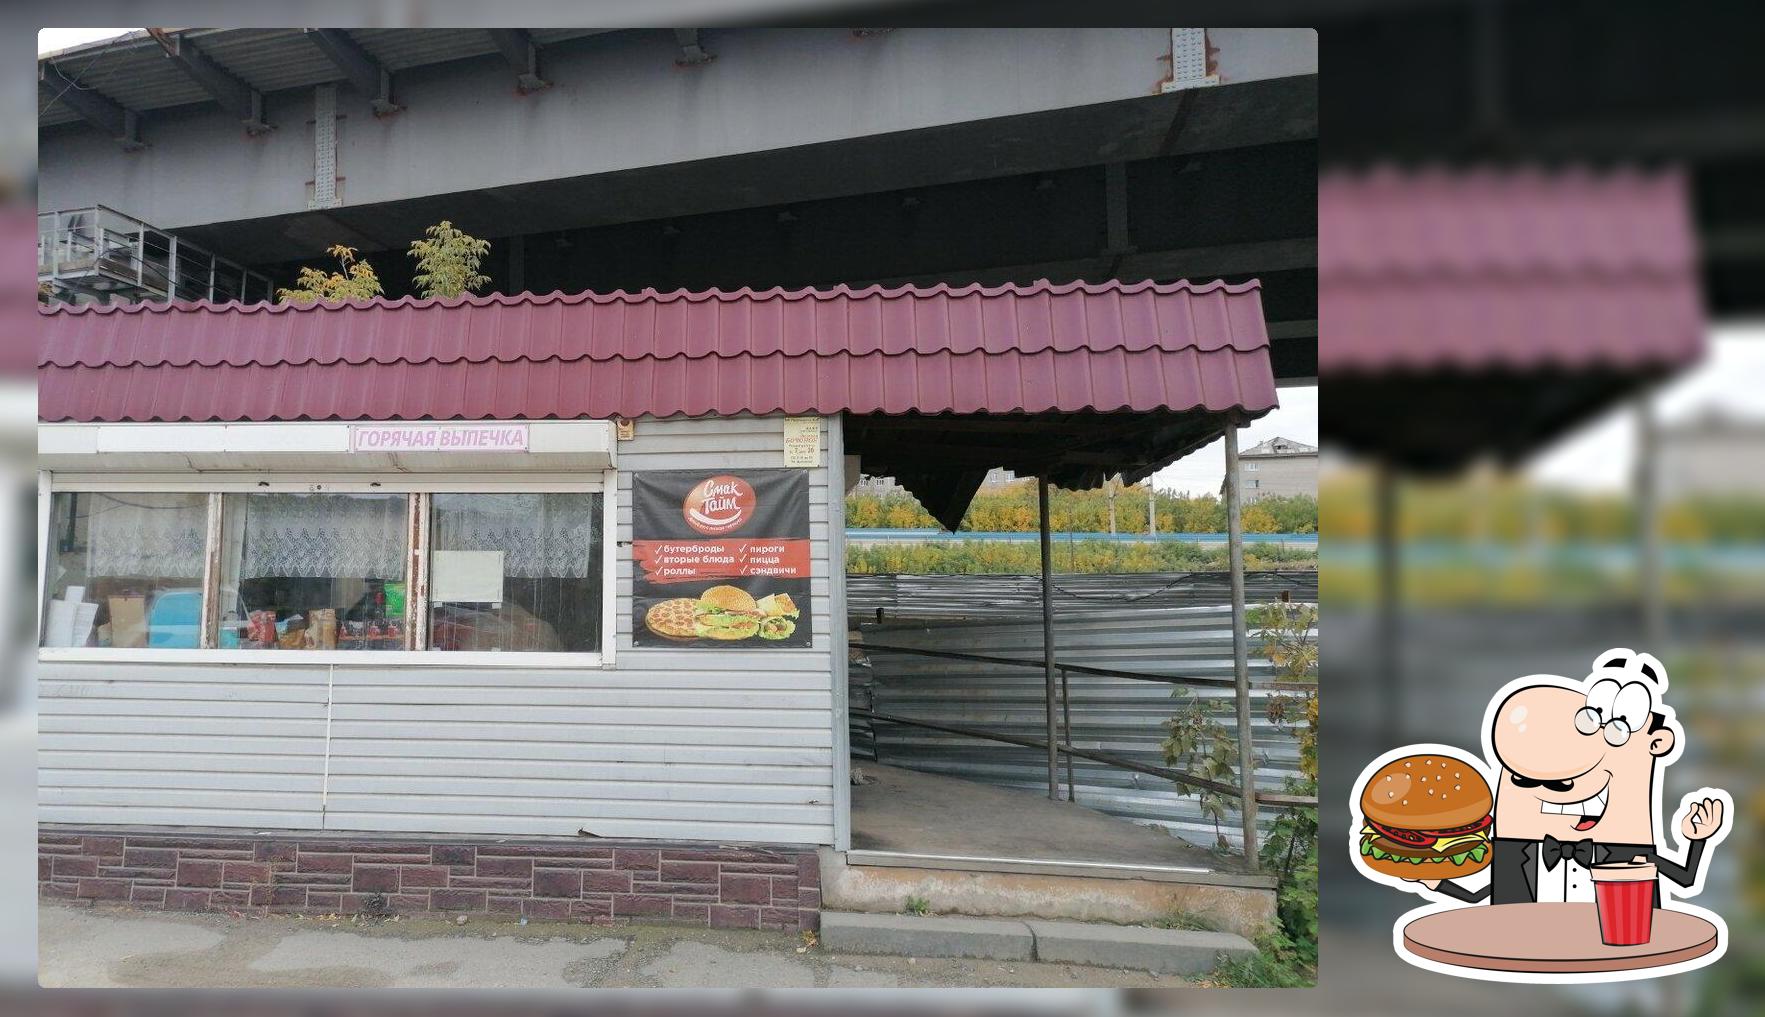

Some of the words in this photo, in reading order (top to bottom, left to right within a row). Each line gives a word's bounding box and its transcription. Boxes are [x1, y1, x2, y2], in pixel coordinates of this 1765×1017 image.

[358, 430, 437, 447] ГОРЯЧАЯ
[439, 429, 524, 447] ВЫПЕЧКА
[703, 480, 744, 498] Смак
[701, 496, 742, 515] Тайм
[663, 544, 725, 555] бутерброды
[750, 545, 785, 555] пироги
[663, 556, 700, 566] вторые
[702, 555, 735, 565] блюда
[750, 556, 780, 566] пицца
[663, 567, 697, 577] роллы
[750, 566, 798, 576] сэндвичи
